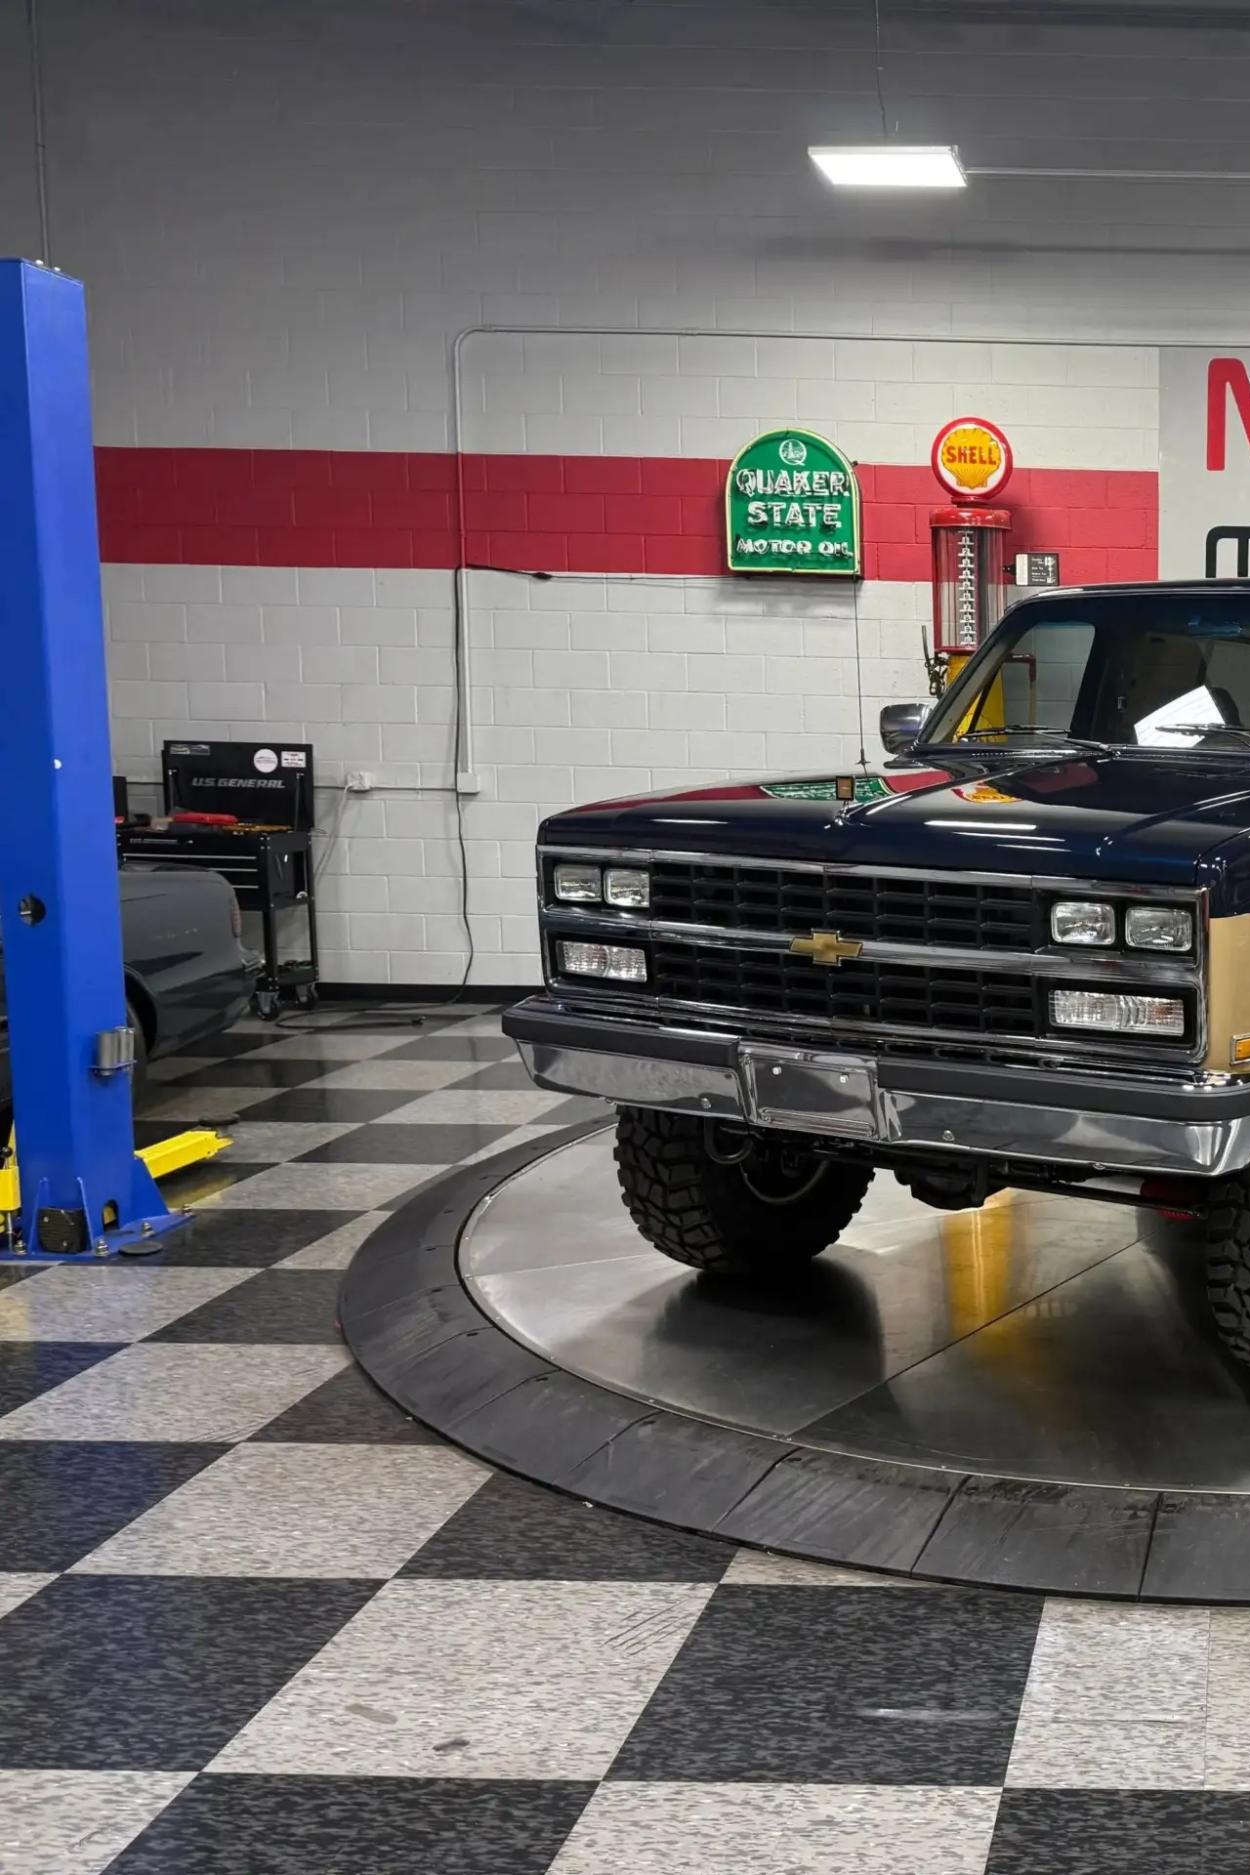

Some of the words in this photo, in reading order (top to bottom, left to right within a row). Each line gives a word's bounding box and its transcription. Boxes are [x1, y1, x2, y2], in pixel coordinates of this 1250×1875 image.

[945, 445, 997, 465] SHELL
[735, 468, 850, 497] QUAKER
[747, 501, 842, 528] STATE
[736, 538, 812, 554] MOTOR
[818, 540, 854, 557] OIL
[217, 777, 286, 789] GENERAL
